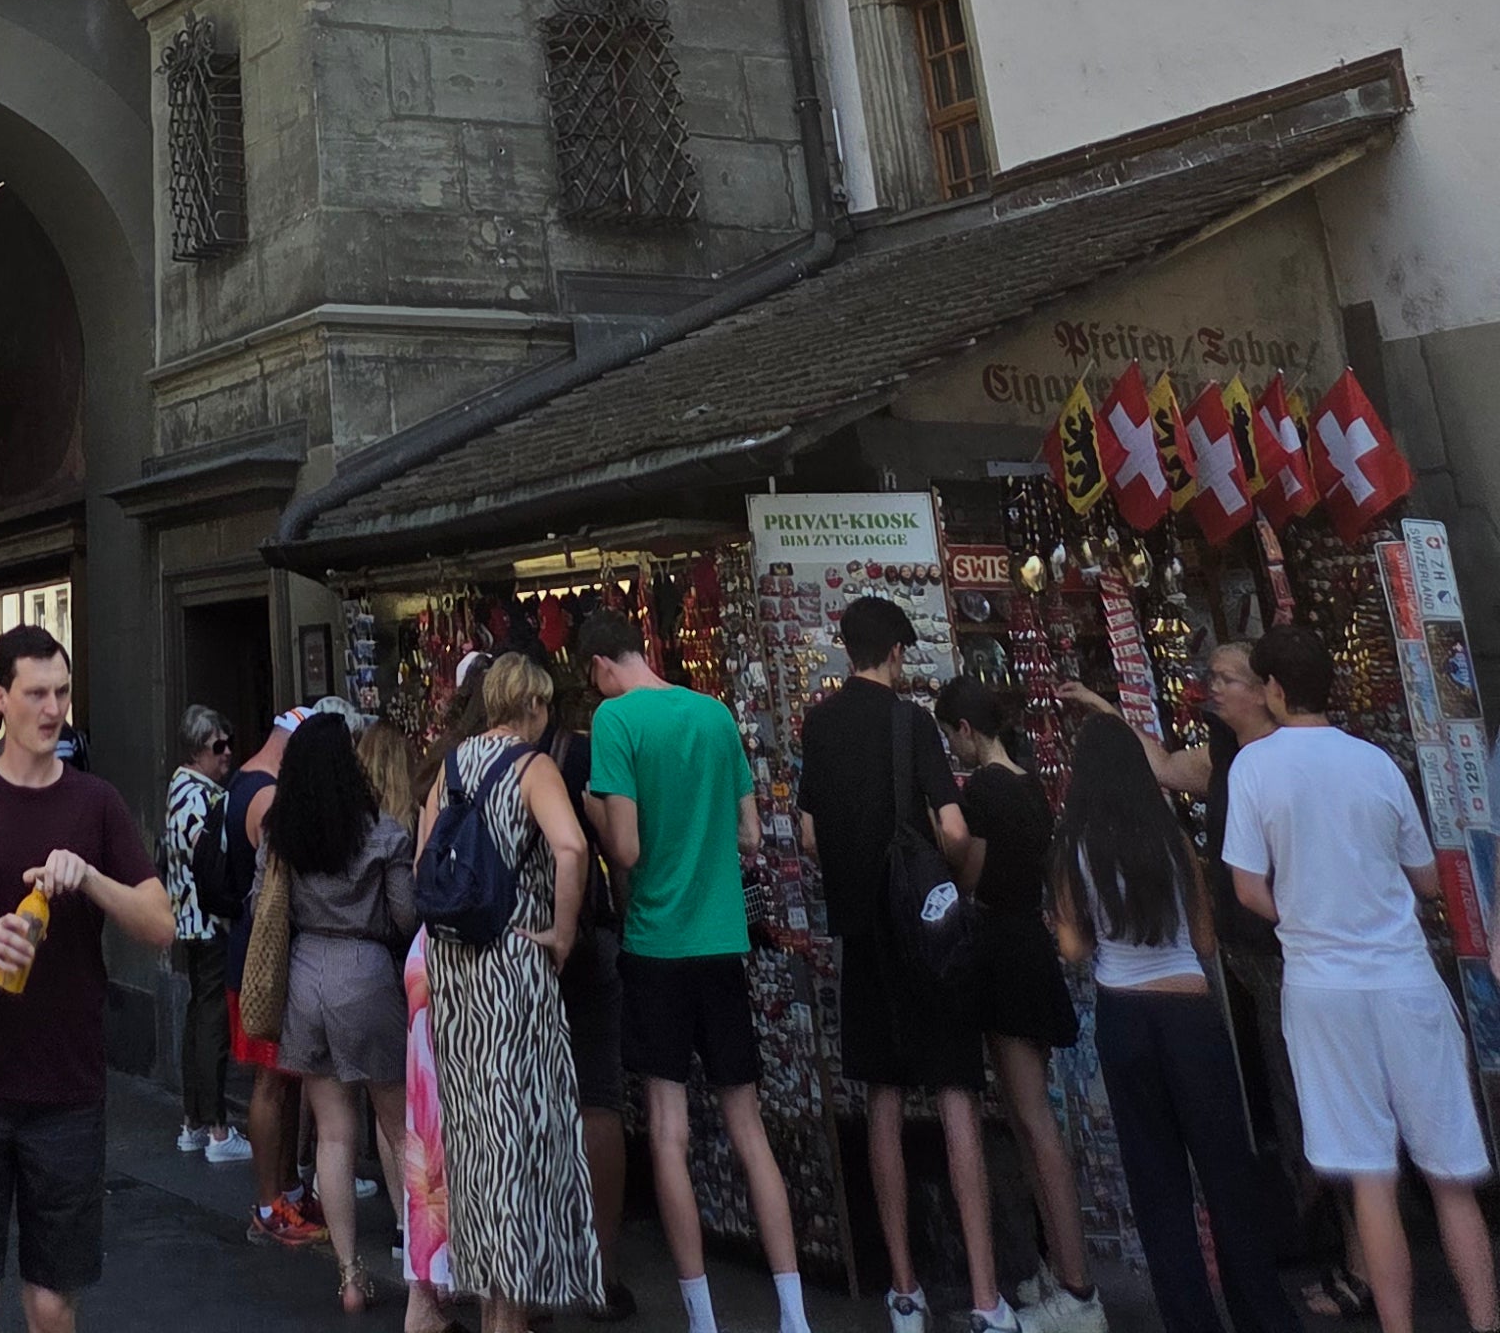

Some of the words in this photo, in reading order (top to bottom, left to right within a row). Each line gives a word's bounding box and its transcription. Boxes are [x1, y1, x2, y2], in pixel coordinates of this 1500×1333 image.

[763, 511, 920, 531] PRIVAT-KIOSK
[779, 533, 810, 548] BIM
[812, 533, 908, 549] ZYTGLOGGE
[952, 554, 1013, 583] SWIS
[1408, 526, 1435, 611] SWITZERLAND
[1461, 751, 1482, 794] 1291
[1424, 750, 1454, 841] SWITZERLAND
